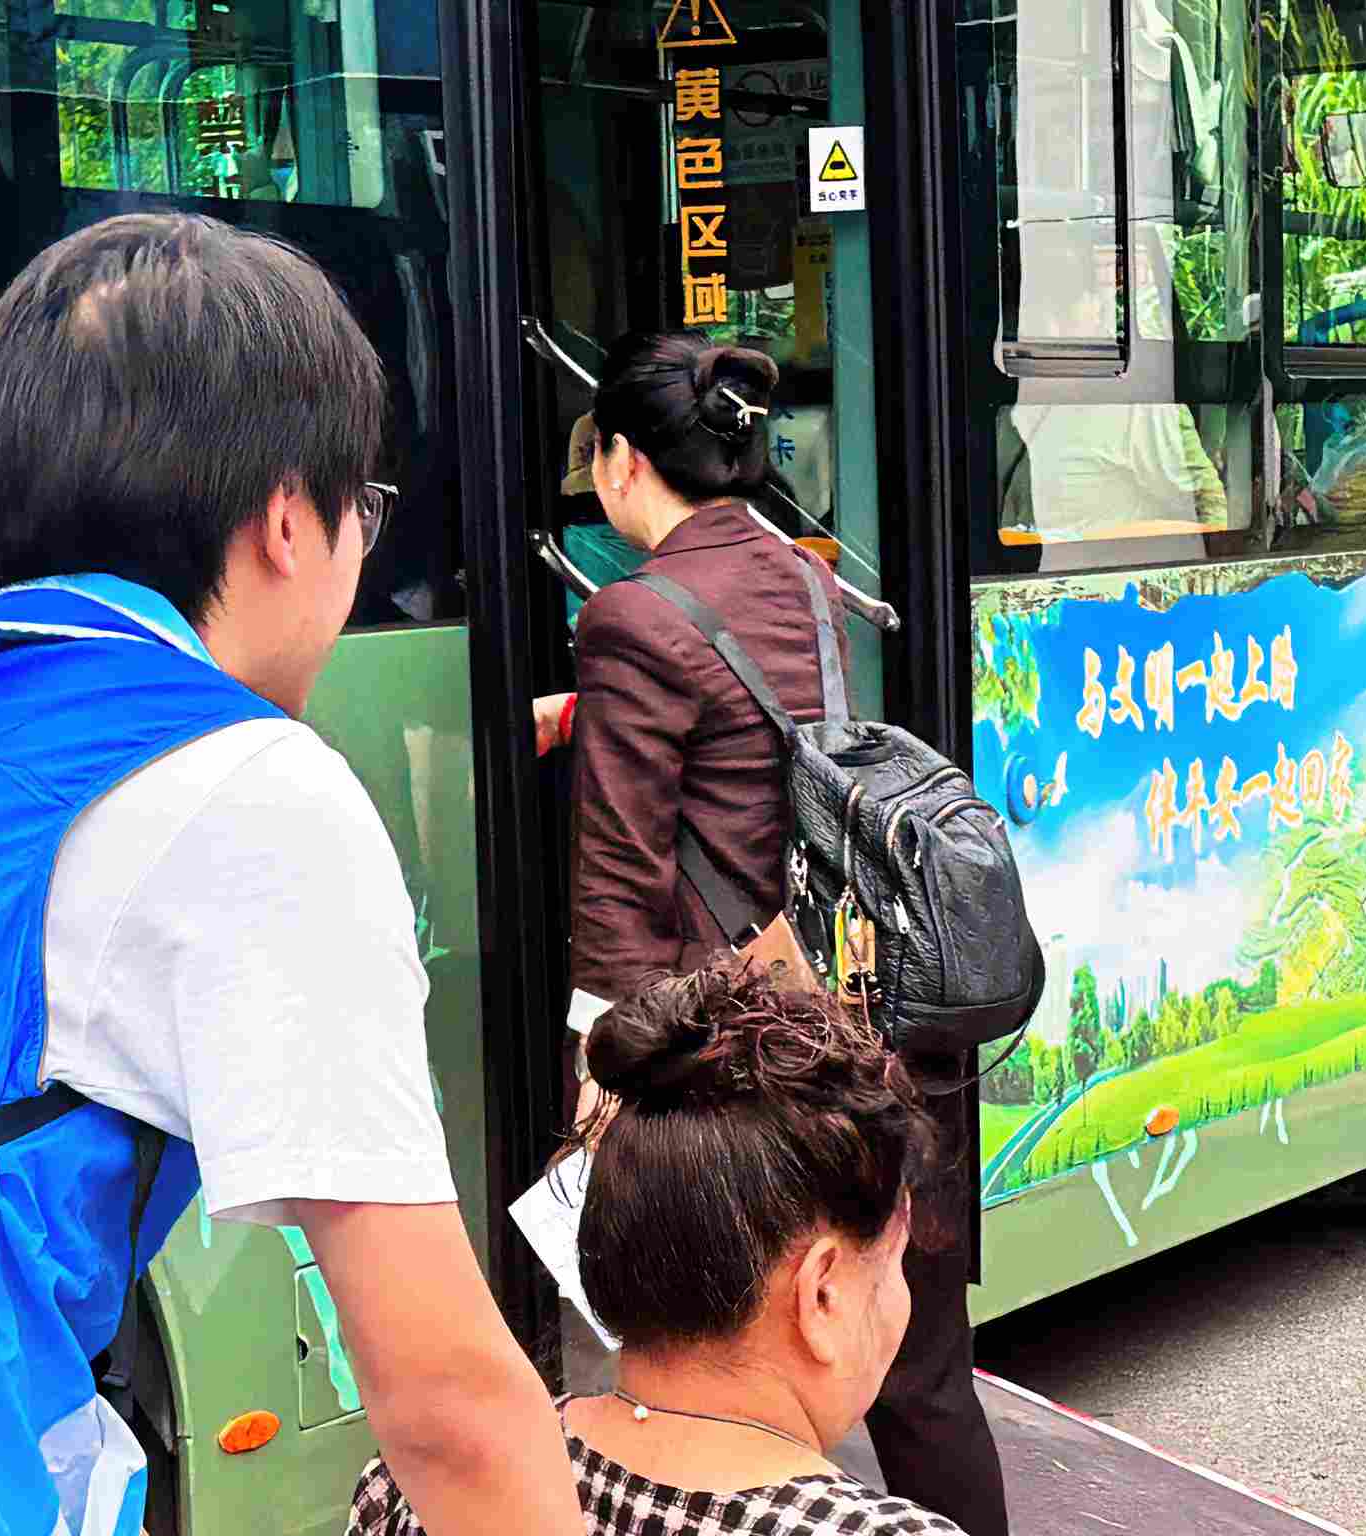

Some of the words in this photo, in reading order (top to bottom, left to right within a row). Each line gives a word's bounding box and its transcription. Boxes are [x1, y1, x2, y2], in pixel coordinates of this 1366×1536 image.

[674, 66, 728, 325] 黄色区域
[1142, 729, 1354, 864] 伴平安一起回家
